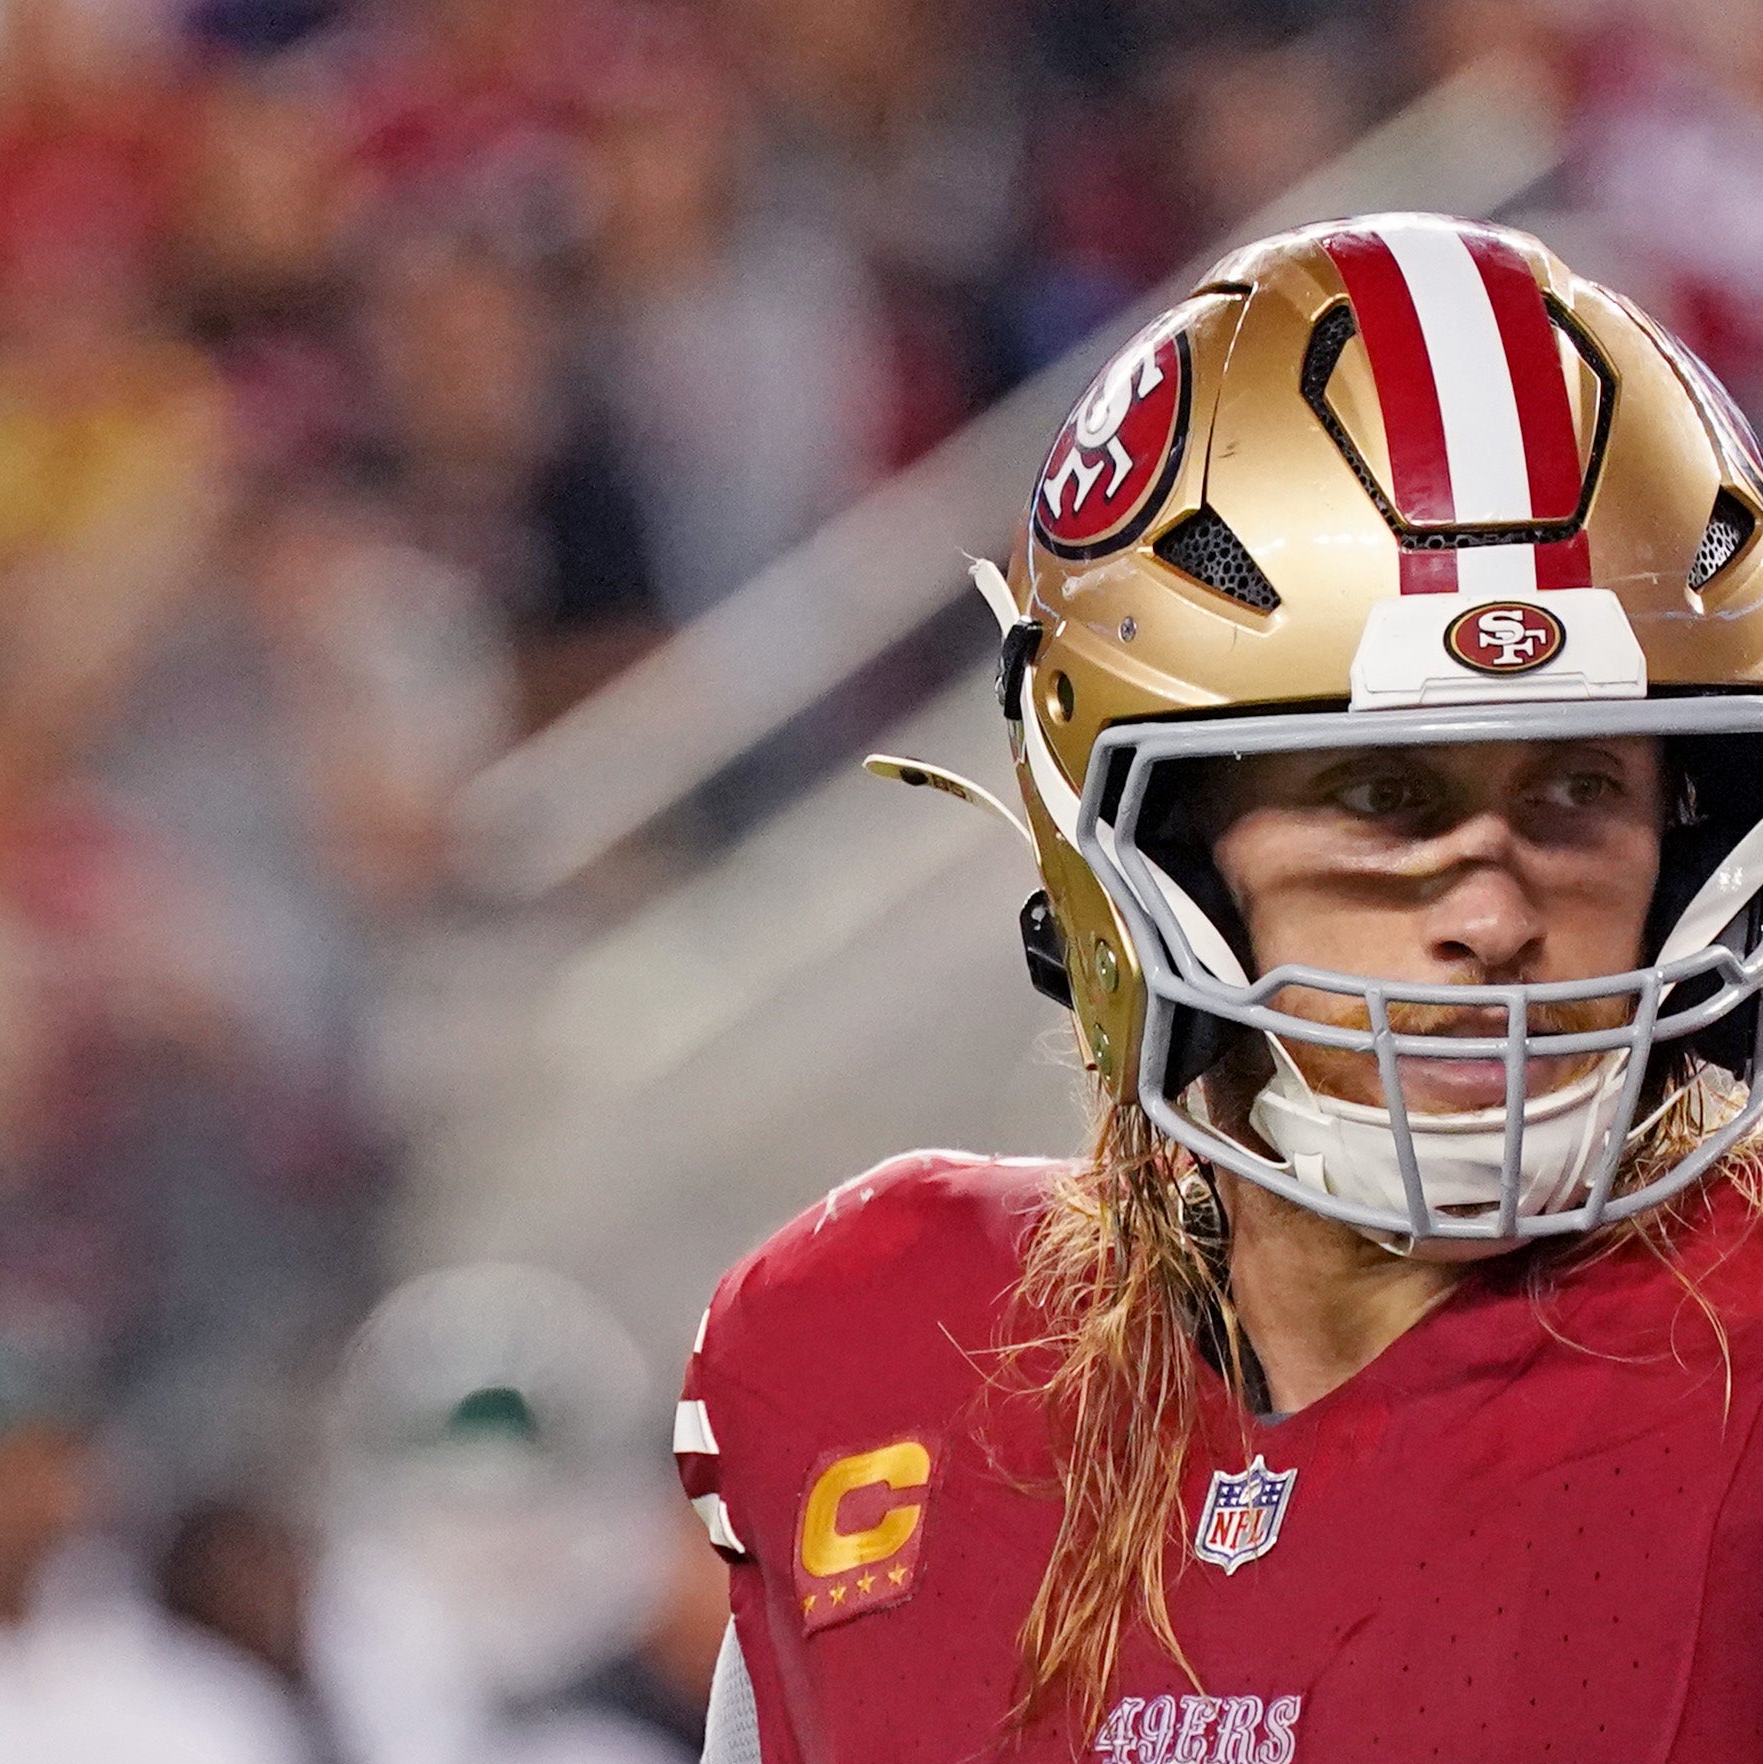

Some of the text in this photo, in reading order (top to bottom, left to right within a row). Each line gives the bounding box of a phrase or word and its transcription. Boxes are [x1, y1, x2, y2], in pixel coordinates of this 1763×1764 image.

[1478, 610, 1546, 665] SF
[801, 1441, 931, 1578] C
[1208, 1507, 1266, 1550] NFL
